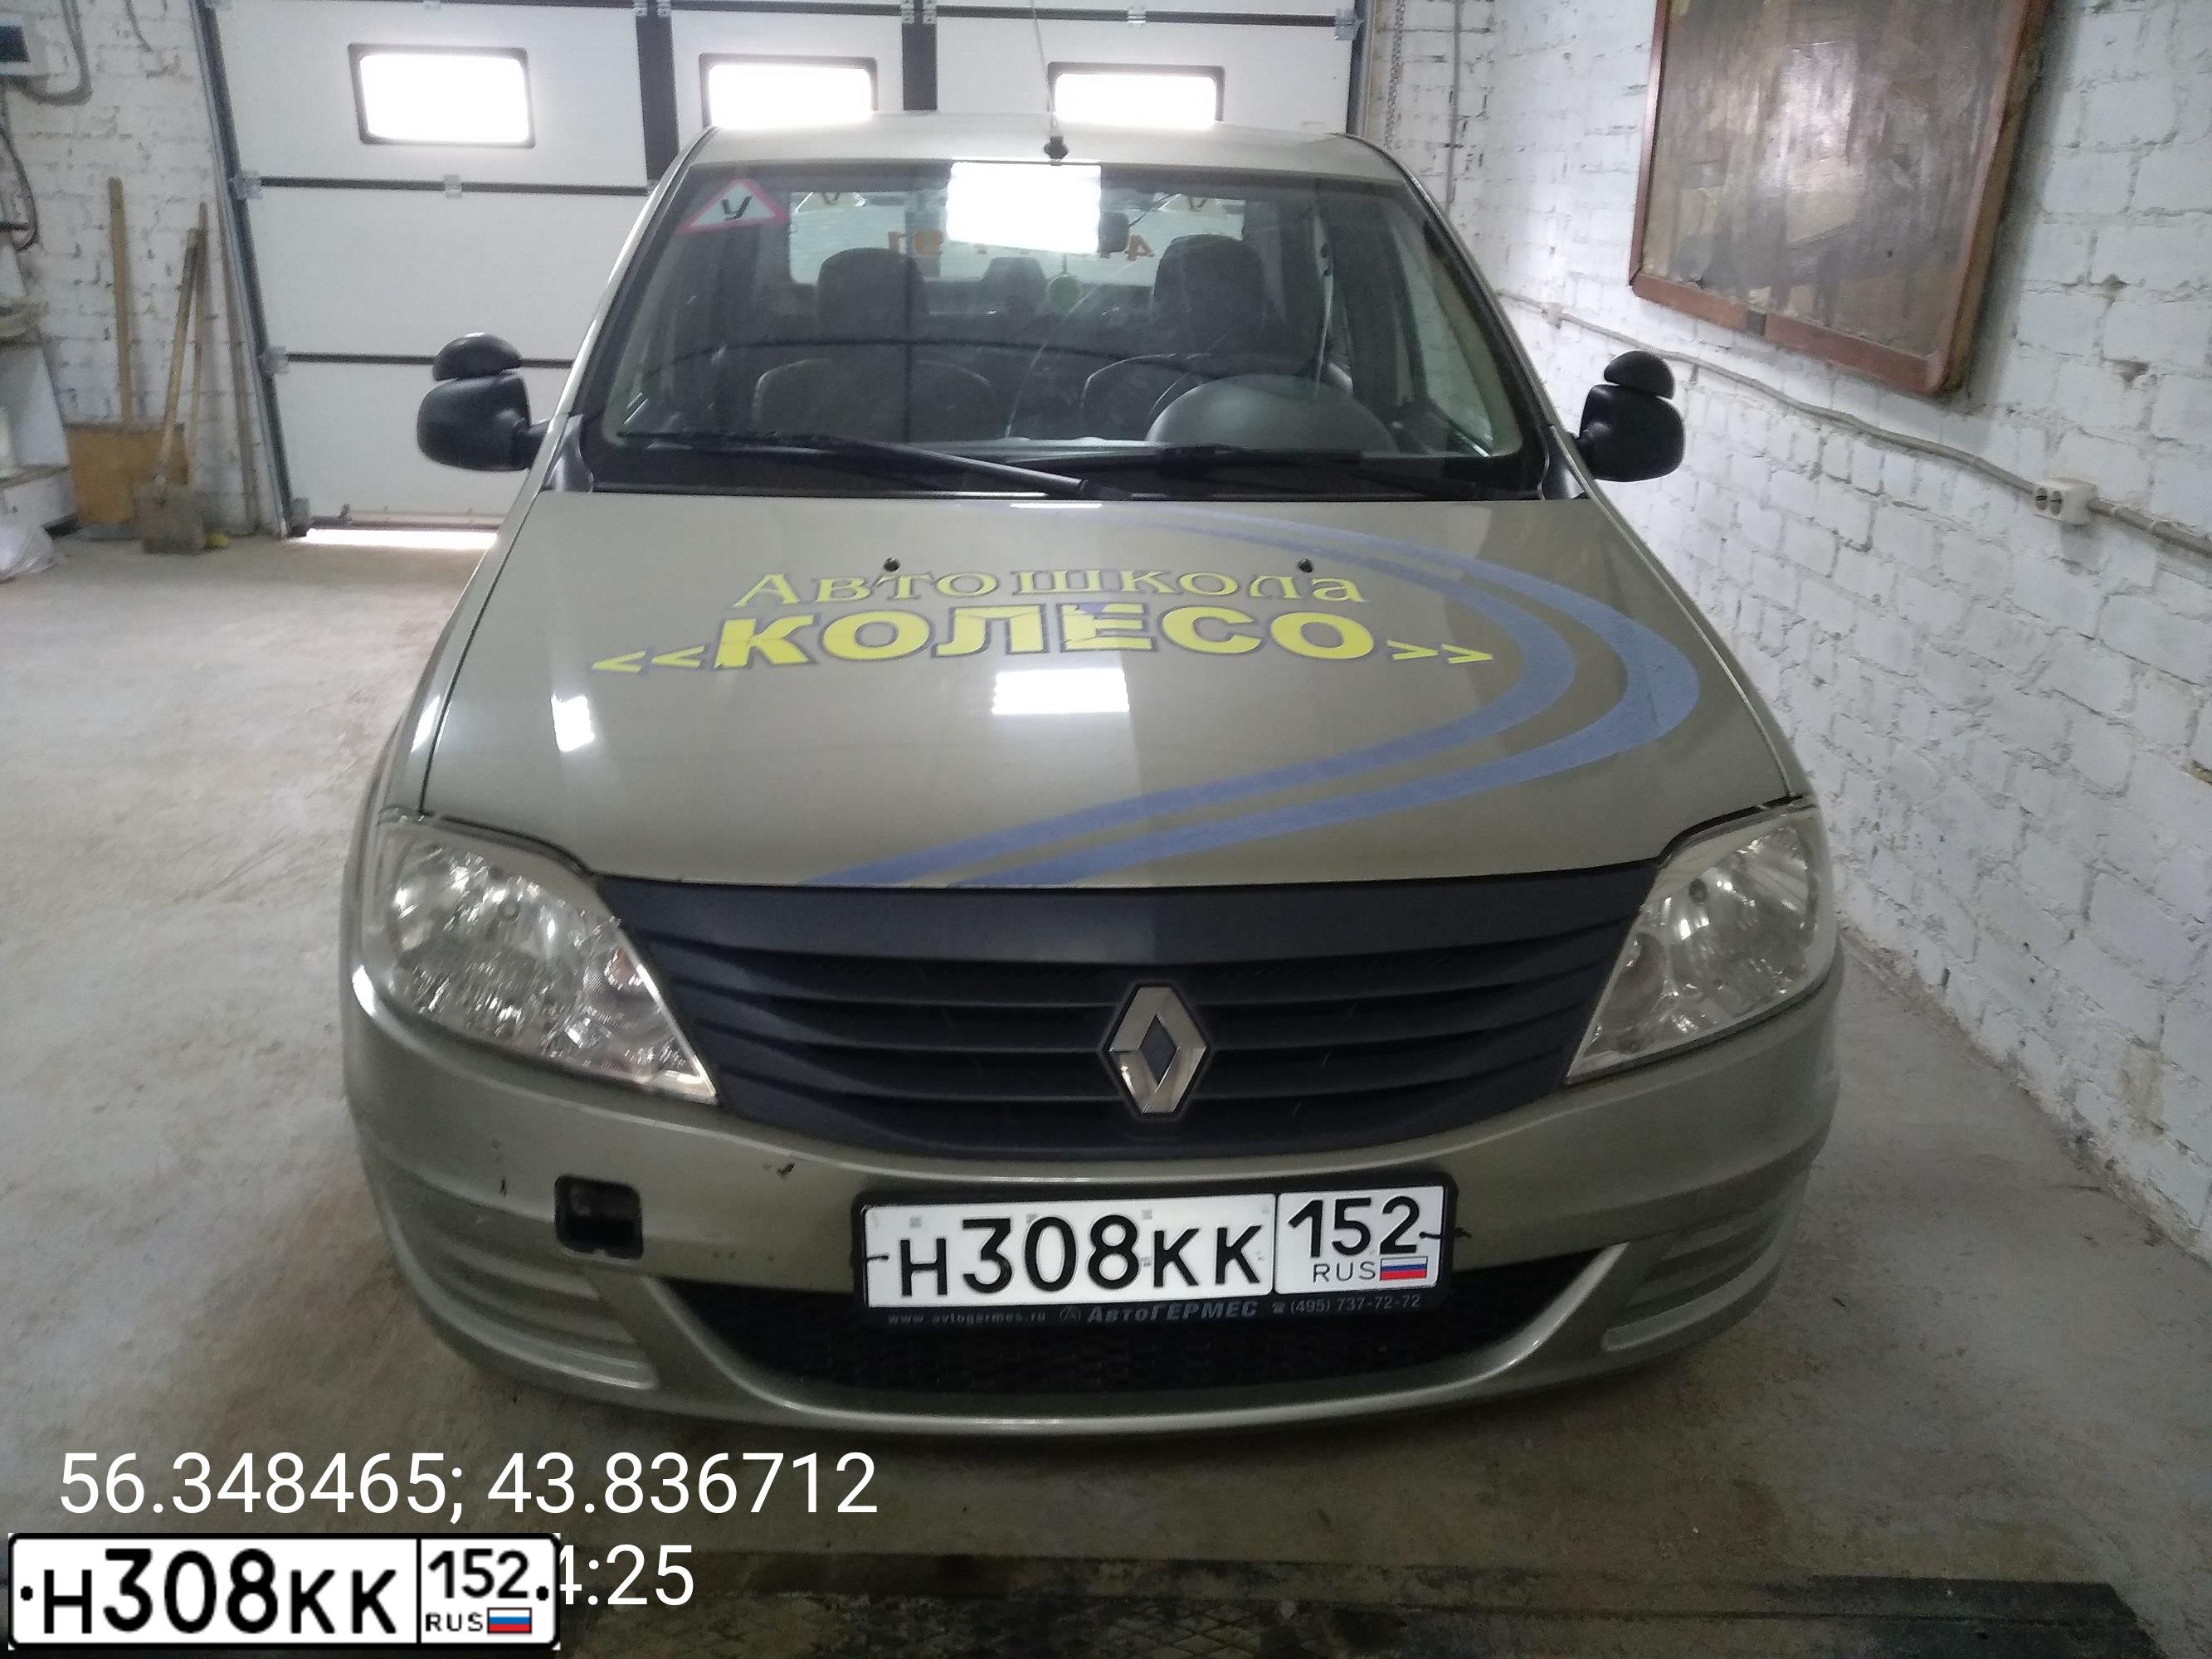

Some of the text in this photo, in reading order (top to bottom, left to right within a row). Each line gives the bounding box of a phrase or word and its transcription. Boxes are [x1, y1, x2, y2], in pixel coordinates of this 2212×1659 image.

[731, 570, 1369, 606] Автошкола
[1288, 1195, 1422, 1259] 152
[1313, 1259, 1376, 1283] RUS
[1086, 1301, 1258, 1322] АвтоГЕРМЕС
[1290, 1294, 1421, 1315] (495) 737-72-72
